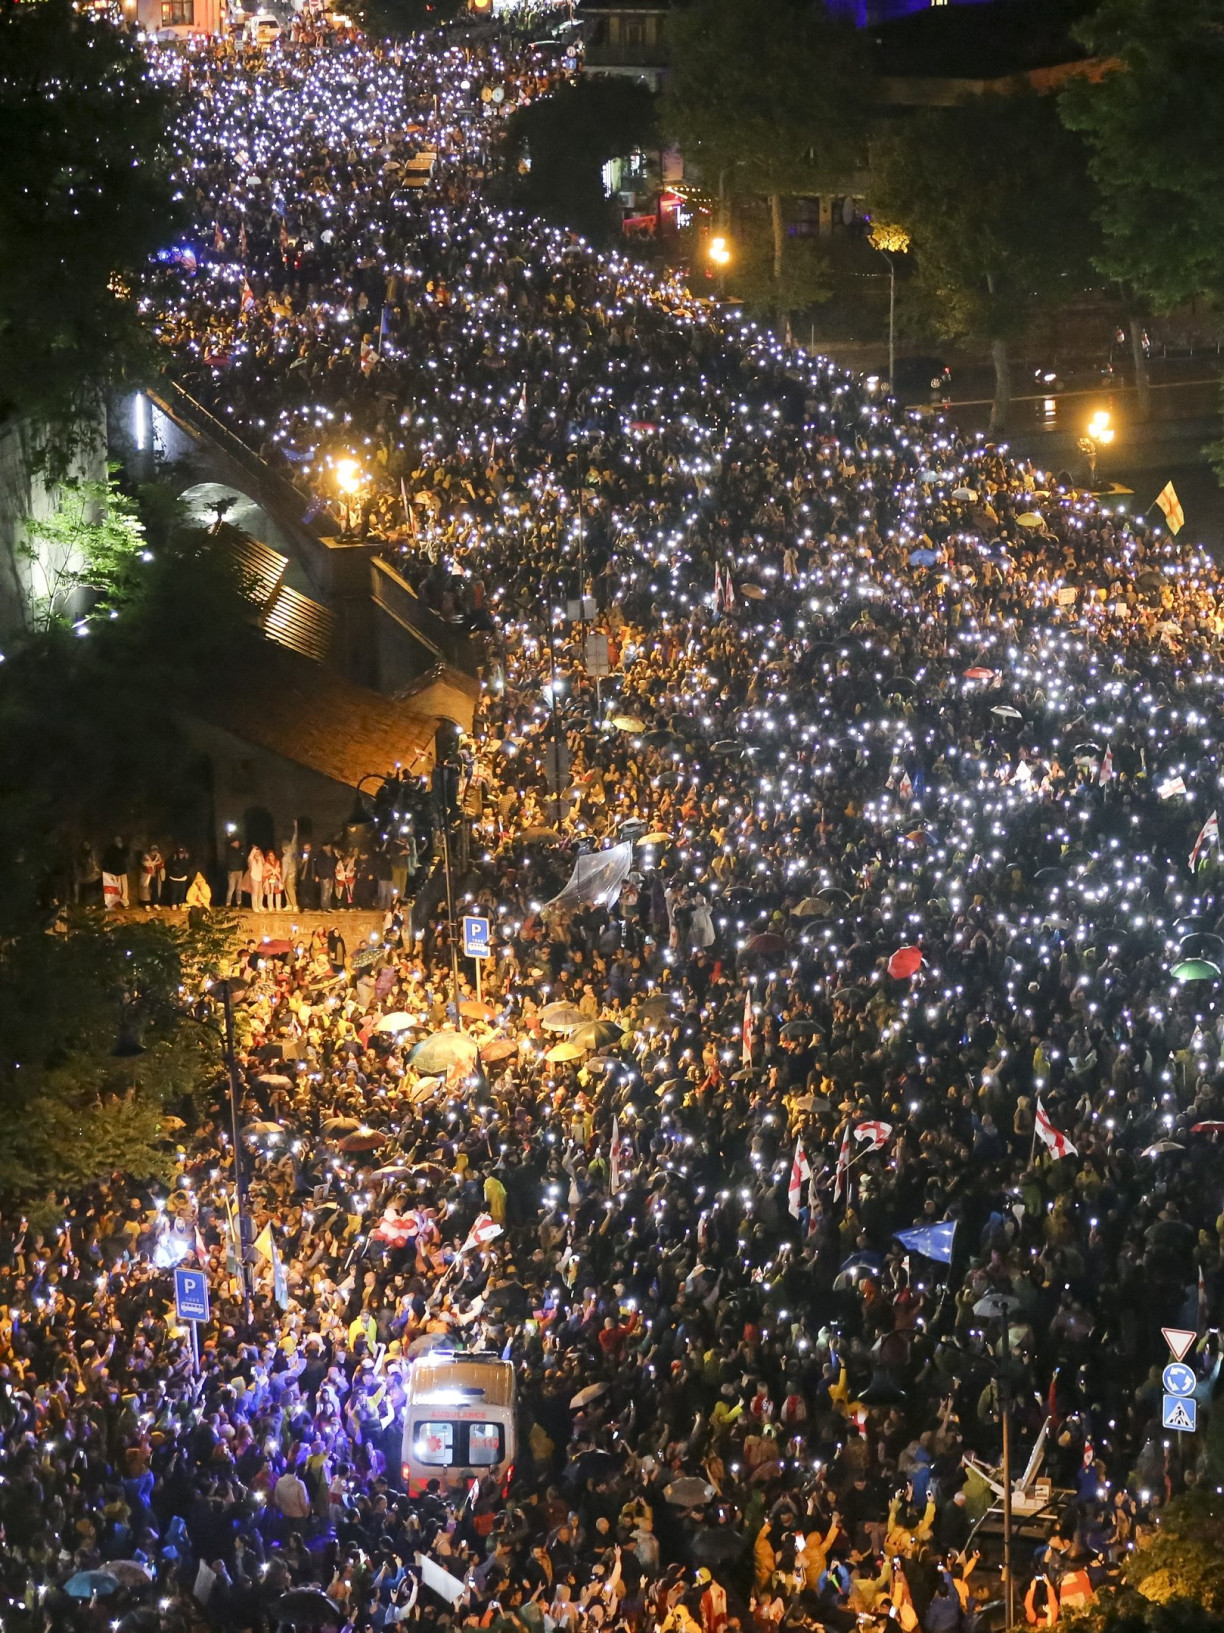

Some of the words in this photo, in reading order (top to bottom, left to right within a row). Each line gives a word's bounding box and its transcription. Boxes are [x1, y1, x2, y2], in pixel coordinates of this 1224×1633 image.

[471, 924, 481, 936] P
[184, 1278, 196, 1294] P
[430, 1411, 487, 1419] AMBULANCE
[482, 1437, 500, 1449] 112
